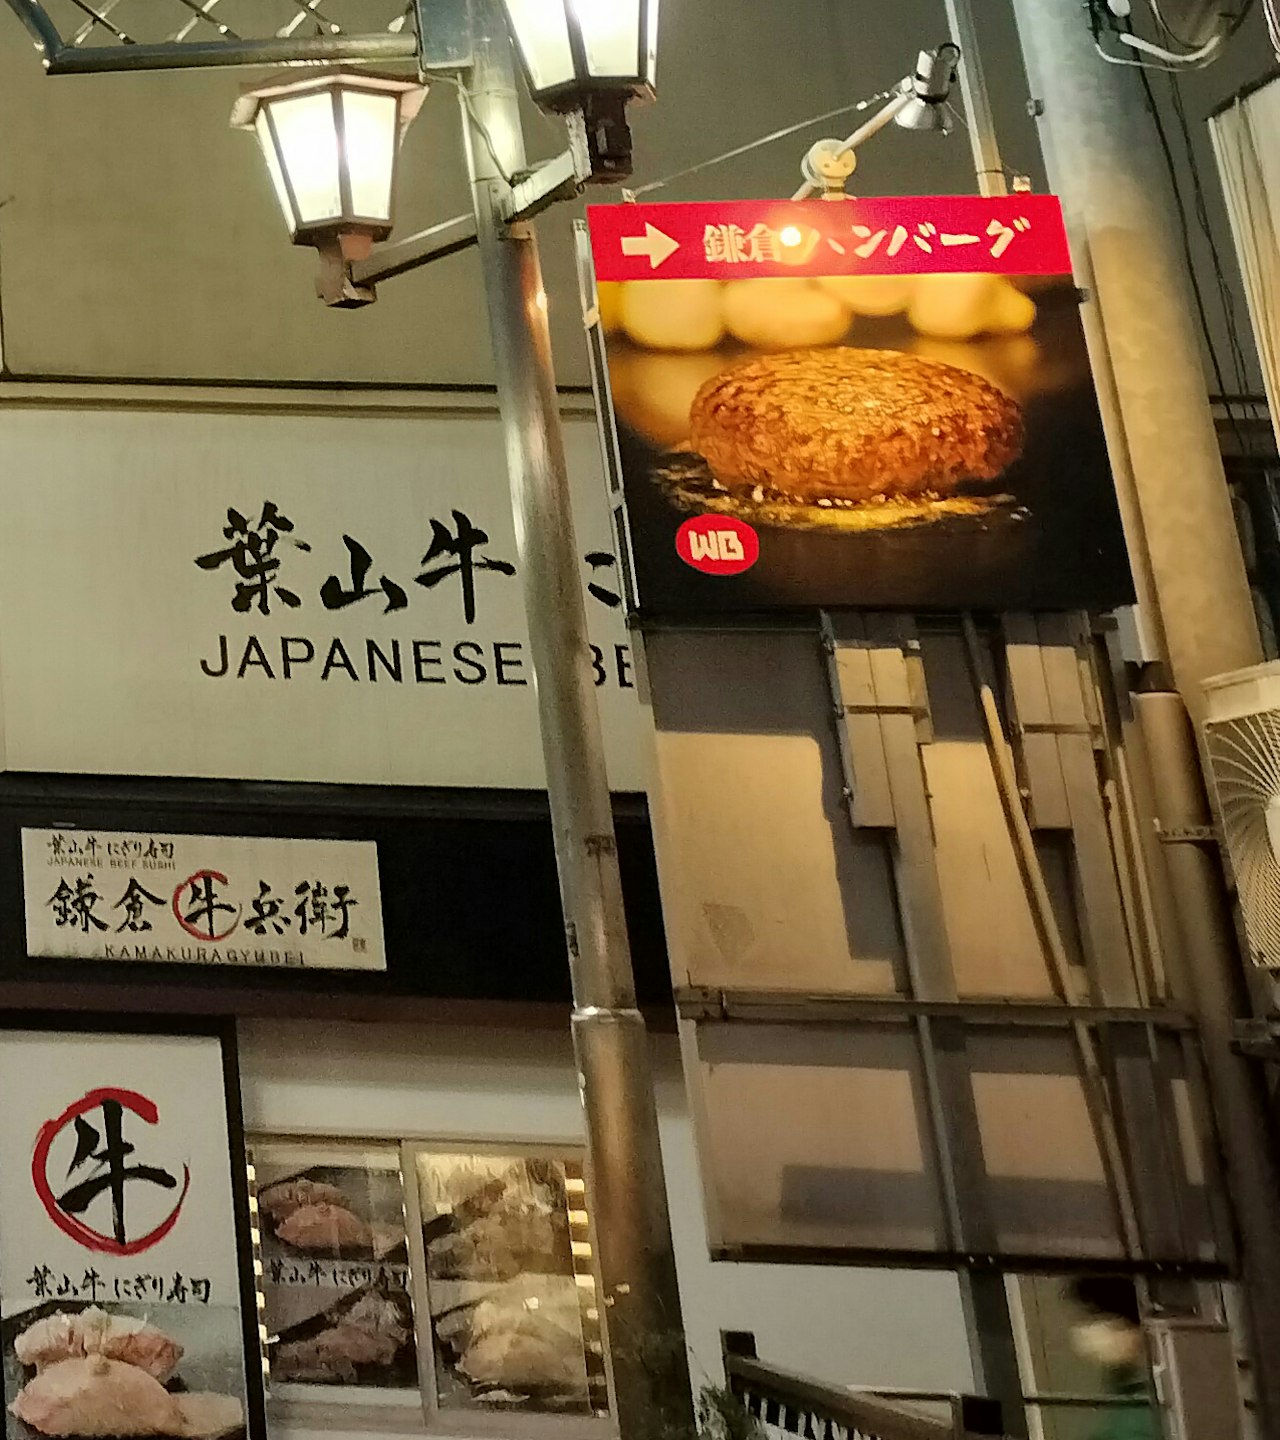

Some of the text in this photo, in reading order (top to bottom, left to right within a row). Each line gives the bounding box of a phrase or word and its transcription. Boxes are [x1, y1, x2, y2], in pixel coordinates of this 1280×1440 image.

[703, 215, 1032, 262] 鎌倉ハンバーグ
[688, 530, 745, 561] WB
[199, 633, 528, 686] JAPANESE
[45, 870, 359, 941] 鎌倉牛兵衛
[55, 1098, 178, 1246] 牛
